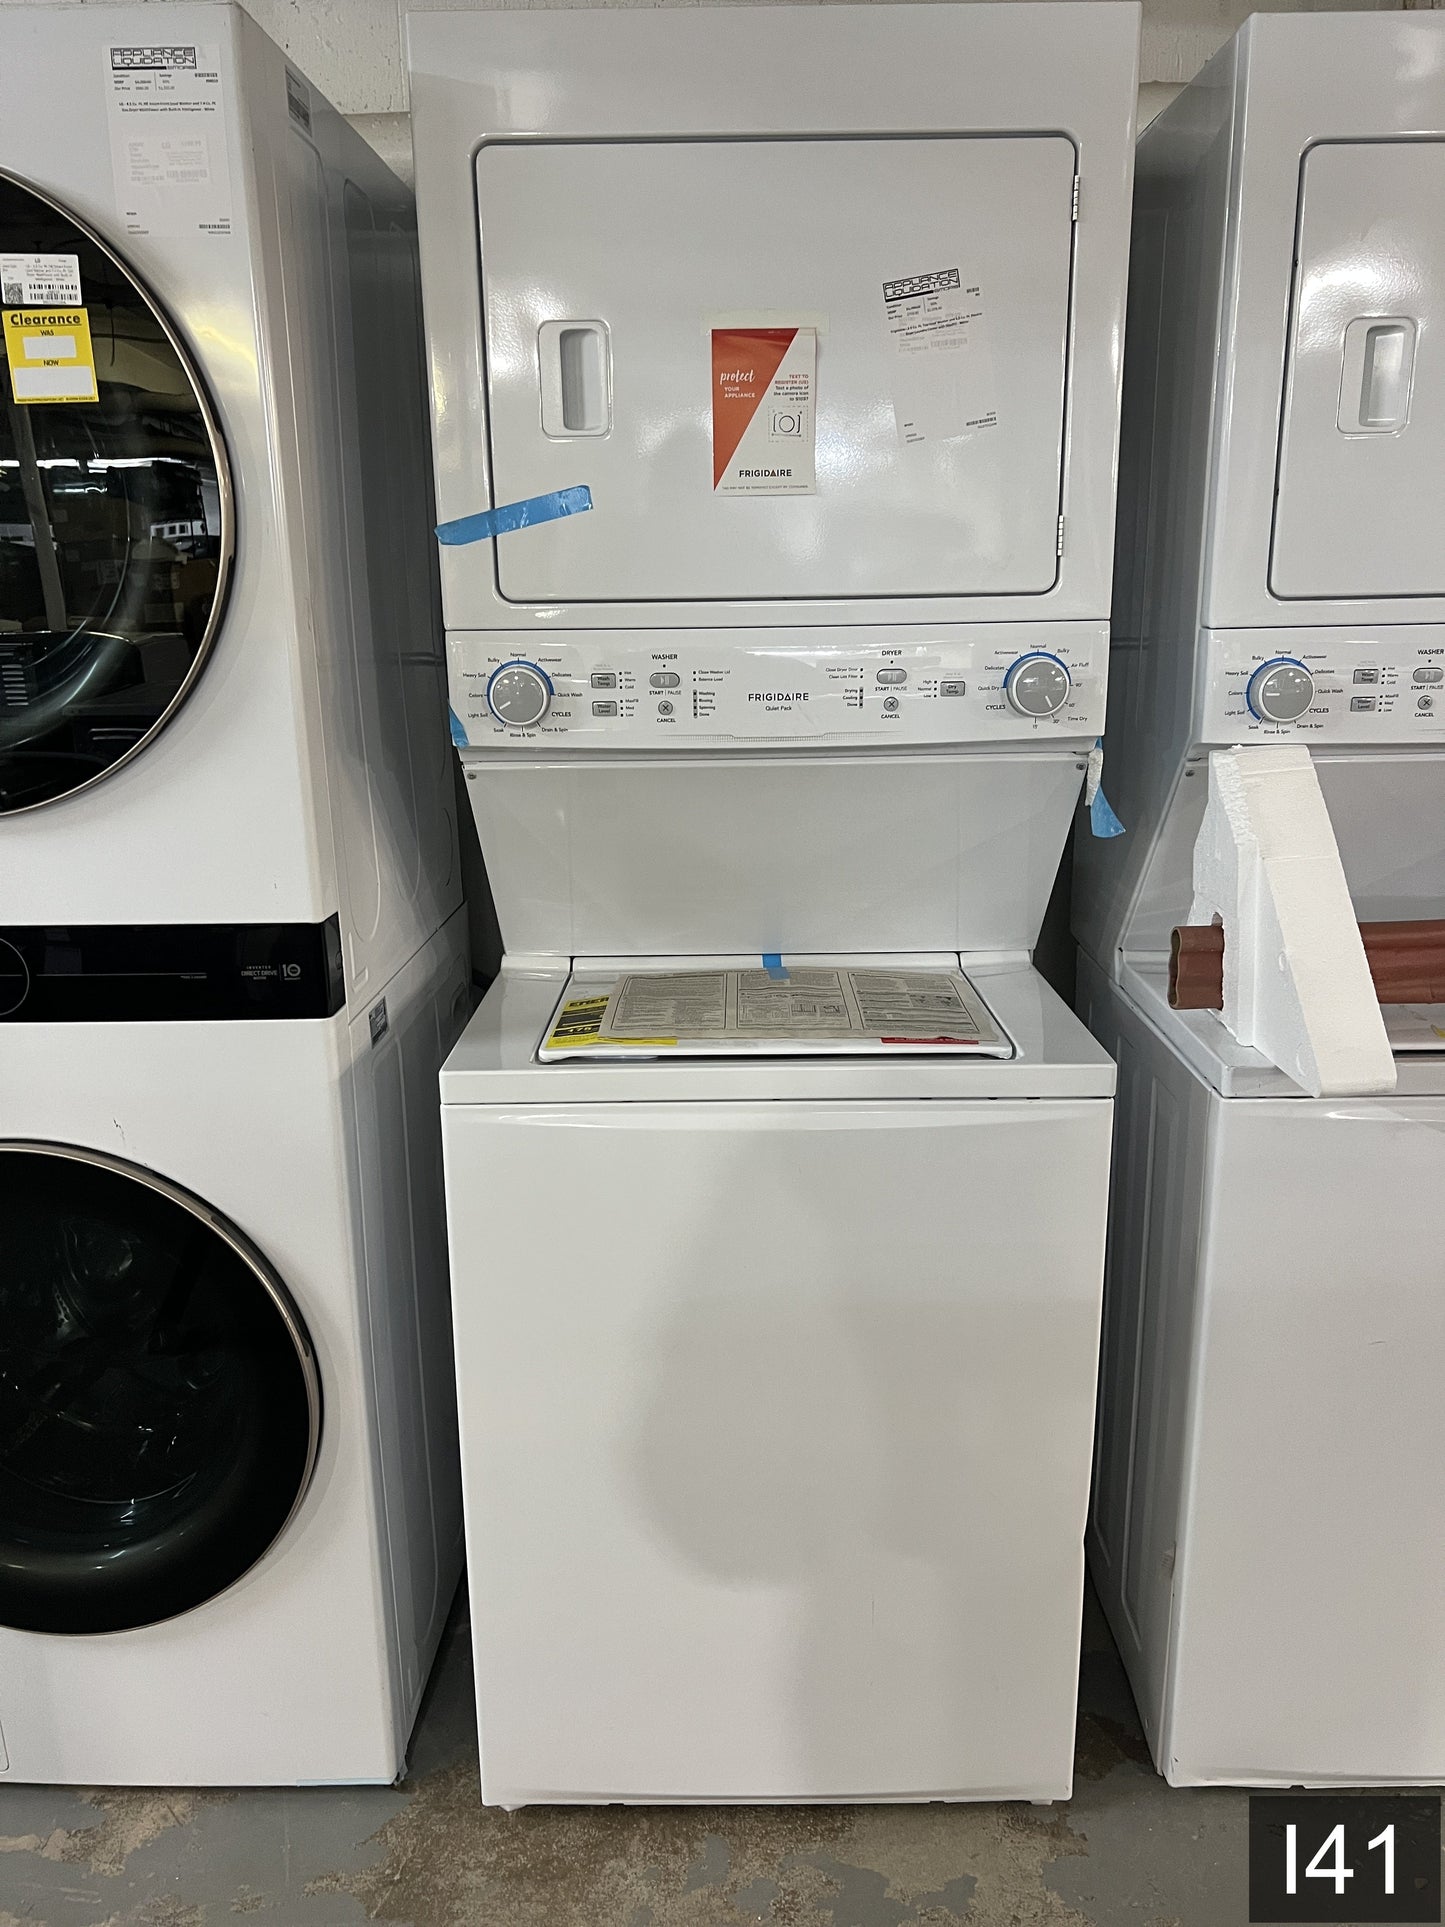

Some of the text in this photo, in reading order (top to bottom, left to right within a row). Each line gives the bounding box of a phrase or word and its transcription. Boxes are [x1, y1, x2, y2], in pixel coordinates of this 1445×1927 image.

[113, 48, 194, 57] APPLIANCE
[113, 57, 195, 66] LIQUIDATION
[884, 271, 956, 289] APPLIANCE
[886, 279, 958, 298] LIQUIDATION
[10, 313, 80, 325] Clearance
[720, 369, 755, 385] protect
[748, 692, 809, 701] FRIGIDAIRE
[282, 964, 301, 977] 10
